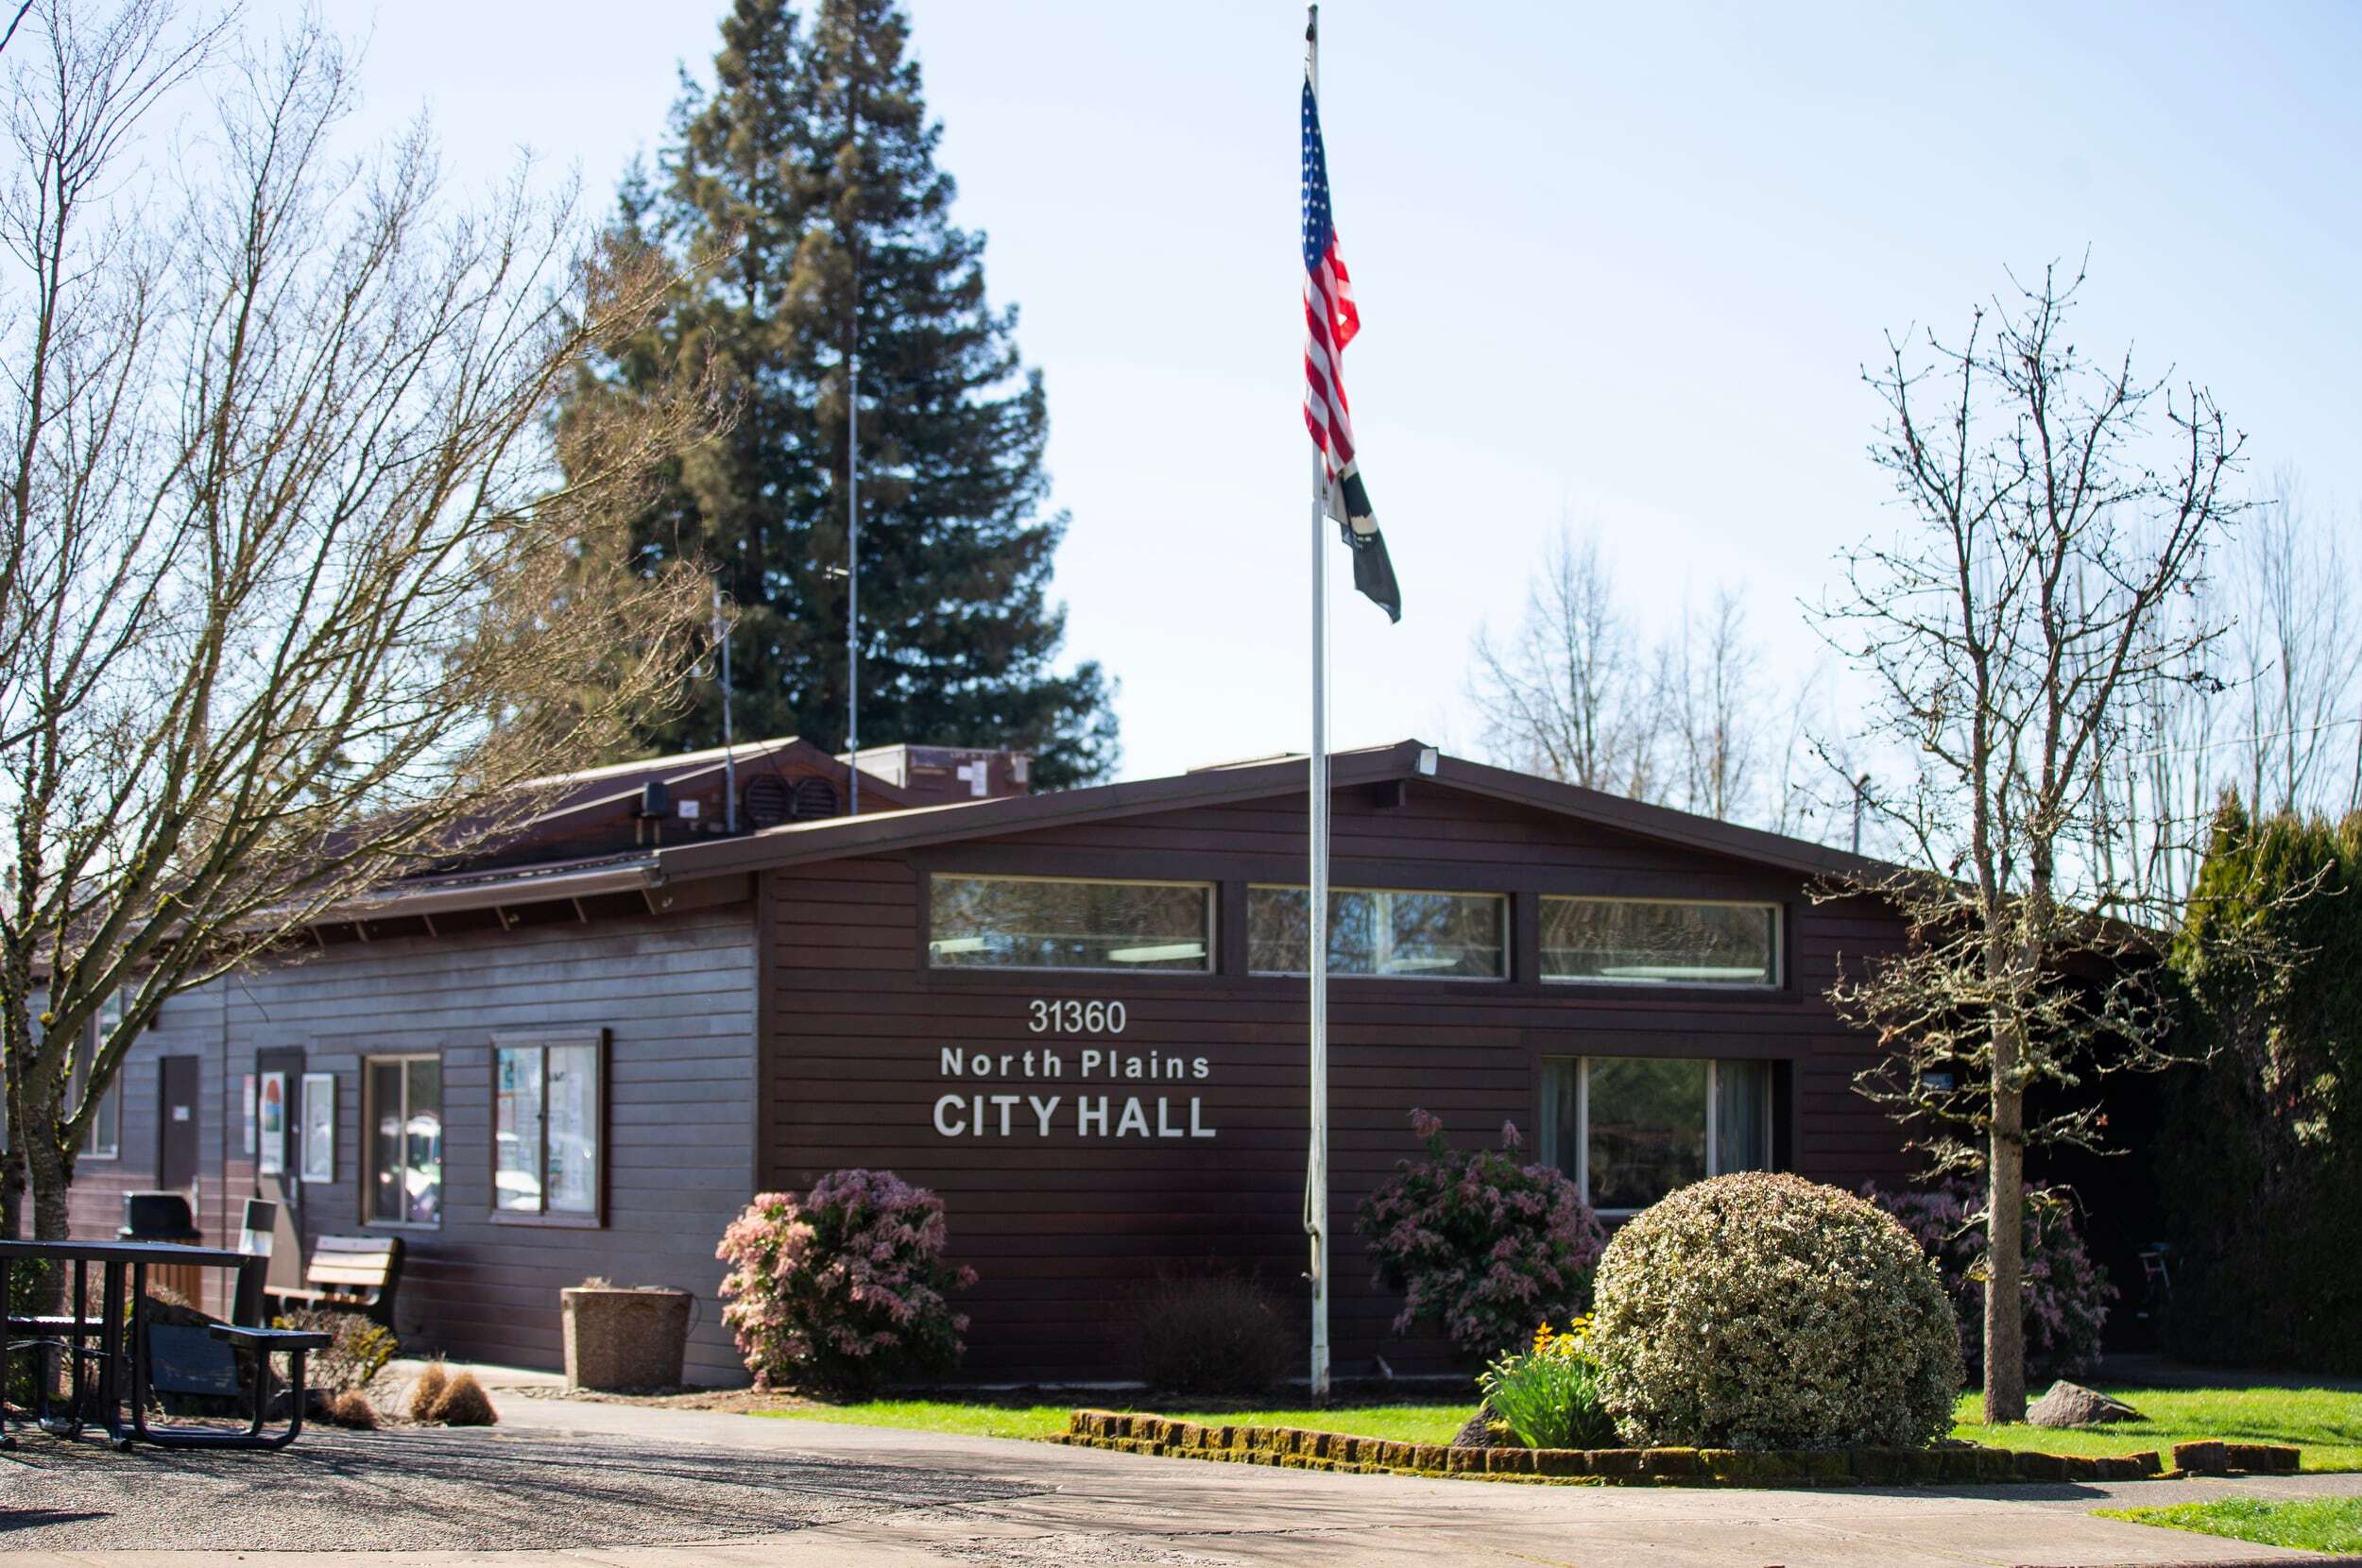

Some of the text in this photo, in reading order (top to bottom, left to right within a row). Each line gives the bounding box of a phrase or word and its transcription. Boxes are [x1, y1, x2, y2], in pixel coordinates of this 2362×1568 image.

[1028, 999, 1126, 1033] 31360
[941, 1047, 1209, 1079] North Plains
[933, 1094, 1217, 1137] CITY HALL
